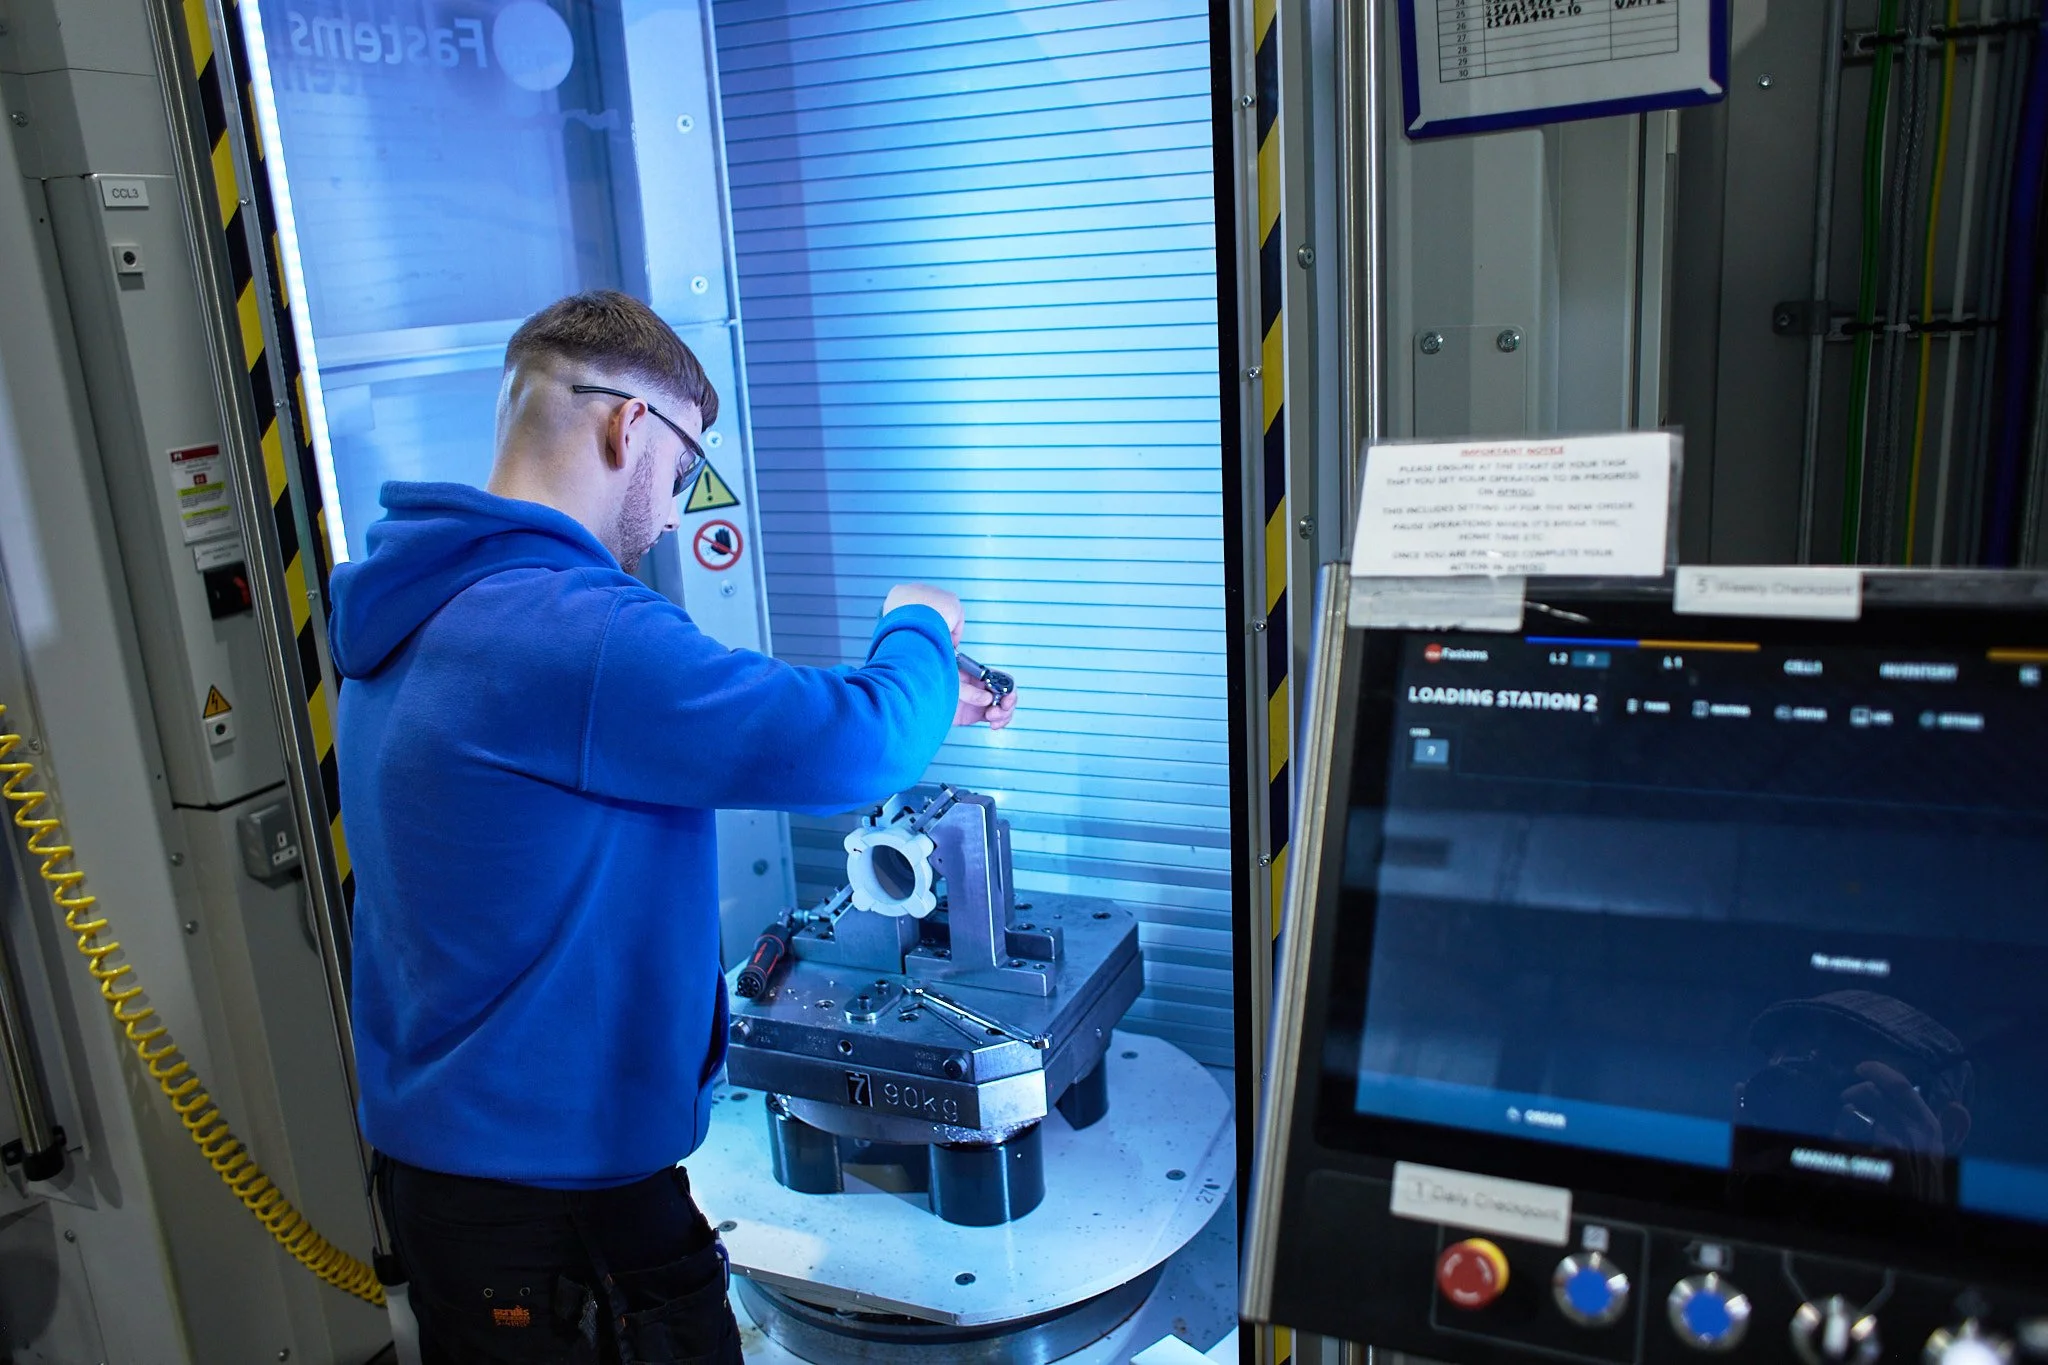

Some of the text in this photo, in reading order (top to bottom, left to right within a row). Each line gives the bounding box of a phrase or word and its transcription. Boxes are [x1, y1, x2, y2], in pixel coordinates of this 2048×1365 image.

[1456, 10, 1466, 19] 25
[1456, 22, 1466, 31] 26
[1457, 34, 1467, 43] 27
[1458, 46, 1468, 55] 28
[1458, 58, 1468, 66] 29
[1459, 69, 1469, 77] 30
[112, 188, 139, 199] CCL3
[1408, 686, 1598, 713] LOADING STATION 2
[848, 1076, 959, 1123] 7 90kg
